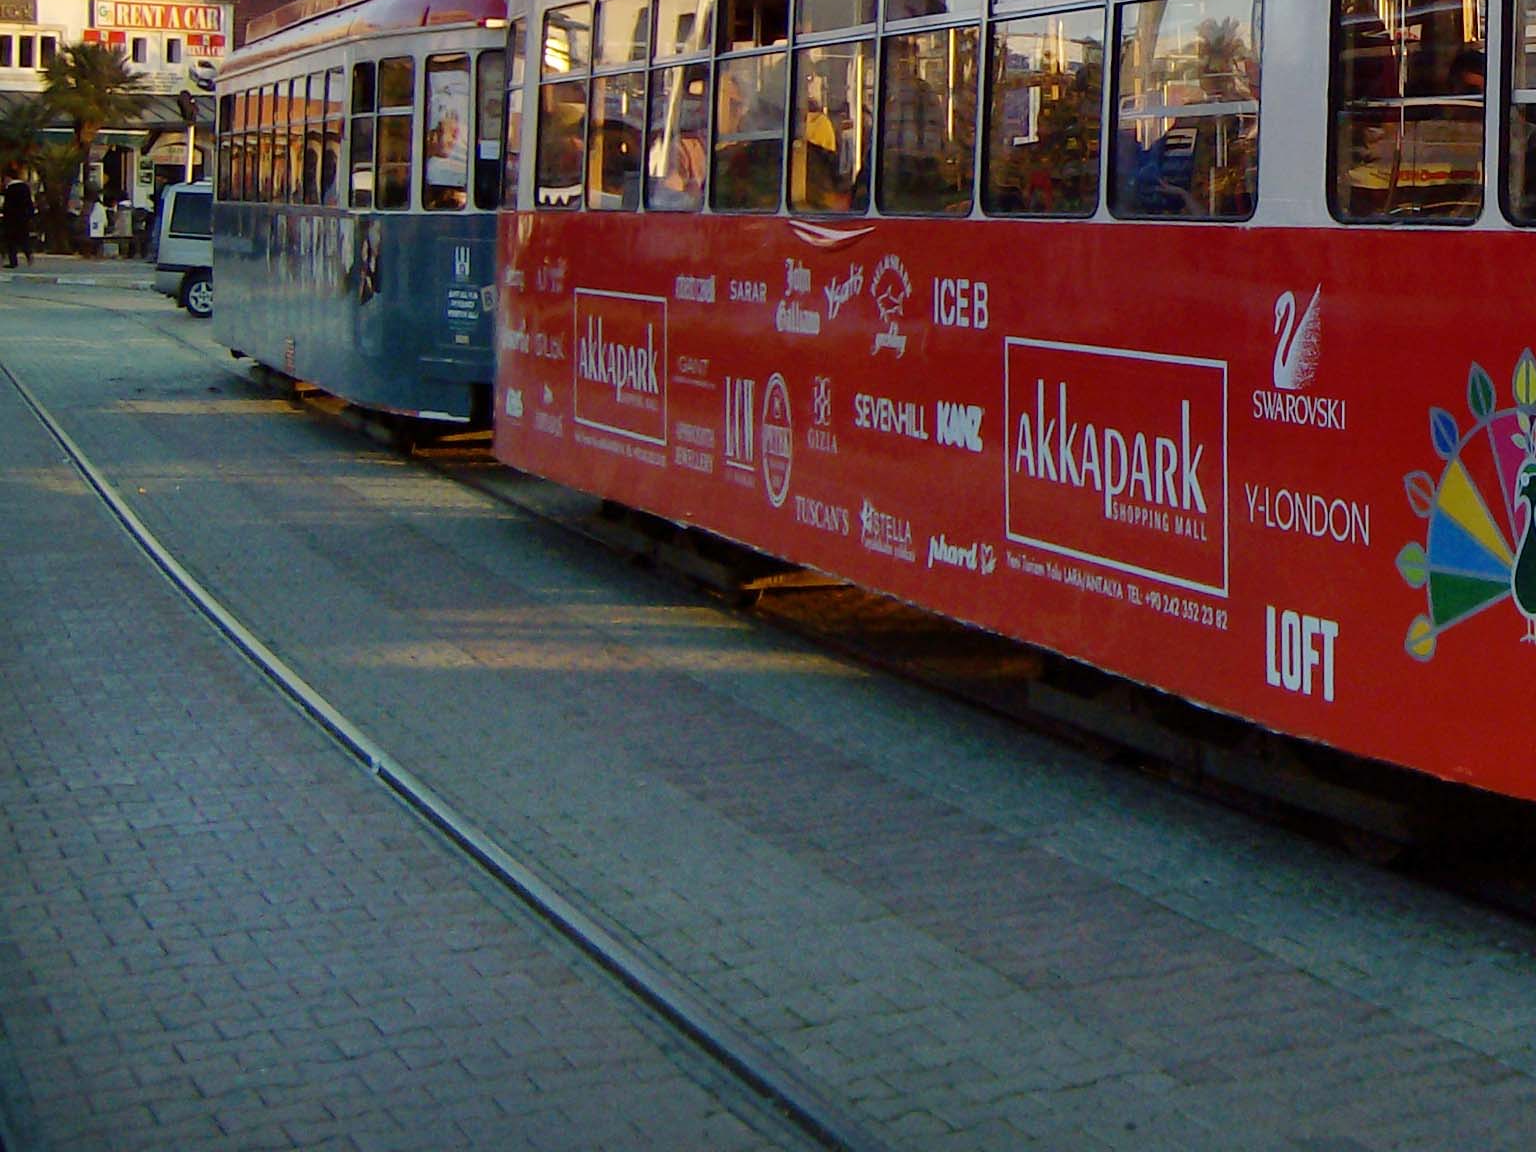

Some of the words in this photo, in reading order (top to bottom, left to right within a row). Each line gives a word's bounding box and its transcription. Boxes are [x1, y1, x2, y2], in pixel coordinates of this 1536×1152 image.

[116, 3, 165, 28] RENT
[167, 5, 180, 29] A
[183, 6, 219, 31] CAR
[729, 279, 768, 305] SARAR
[1252, 389, 1346, 431] SWAROVSKI
[794, 495, 849, 537] TUSCAN'S
[1111, 501, 1170, 533] SHOPPING
[1174, 513, 1208, 542] MALL
[1244, 482, 1370, 547] Y-LONDON
[1144, 590, 1161, 612] +90
[1163, 595, 1180, 617] 242
[1182, 599, 1200, 622] 352
[1201, 605, 1214, 626] 23
[1265, 604, 1339, 703] LOFT
